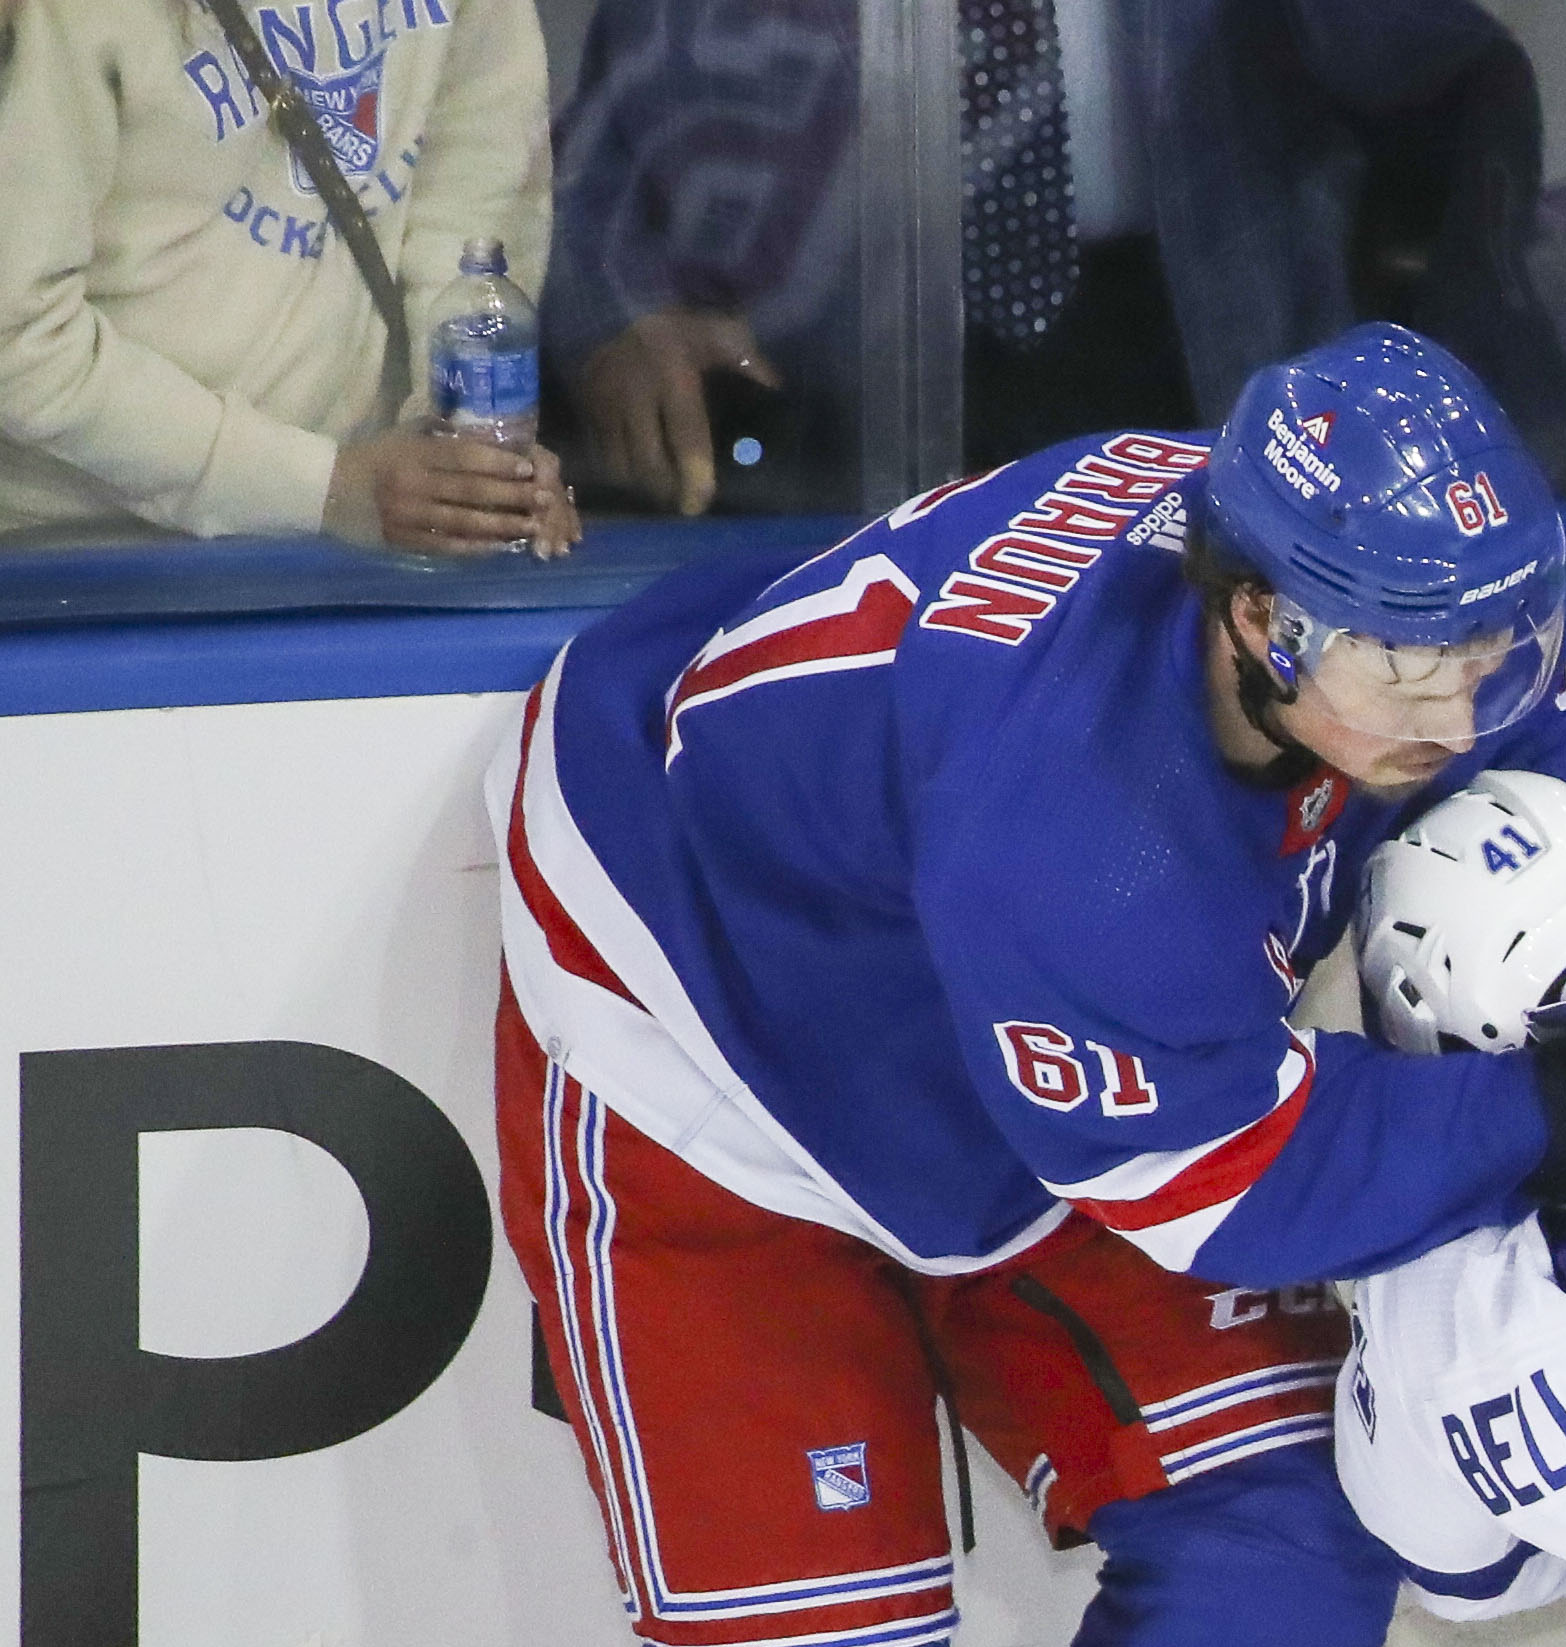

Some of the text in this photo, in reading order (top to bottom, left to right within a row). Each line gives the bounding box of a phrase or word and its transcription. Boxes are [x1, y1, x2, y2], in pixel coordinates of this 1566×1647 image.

[1263, 438, 1314, 500] Moore
[1267, 408, 1341, 492] Benjamin
[1126, 491, 1183, 546] adidas
[1445, 471, 1508, 537] 61
[918, 433, 1212, 646] BRAUN
[1459, 559, 1538, 605] BAUER
[1480, 824, 1542, 876] 41
[994, 1021, 1158, 1118] 61
